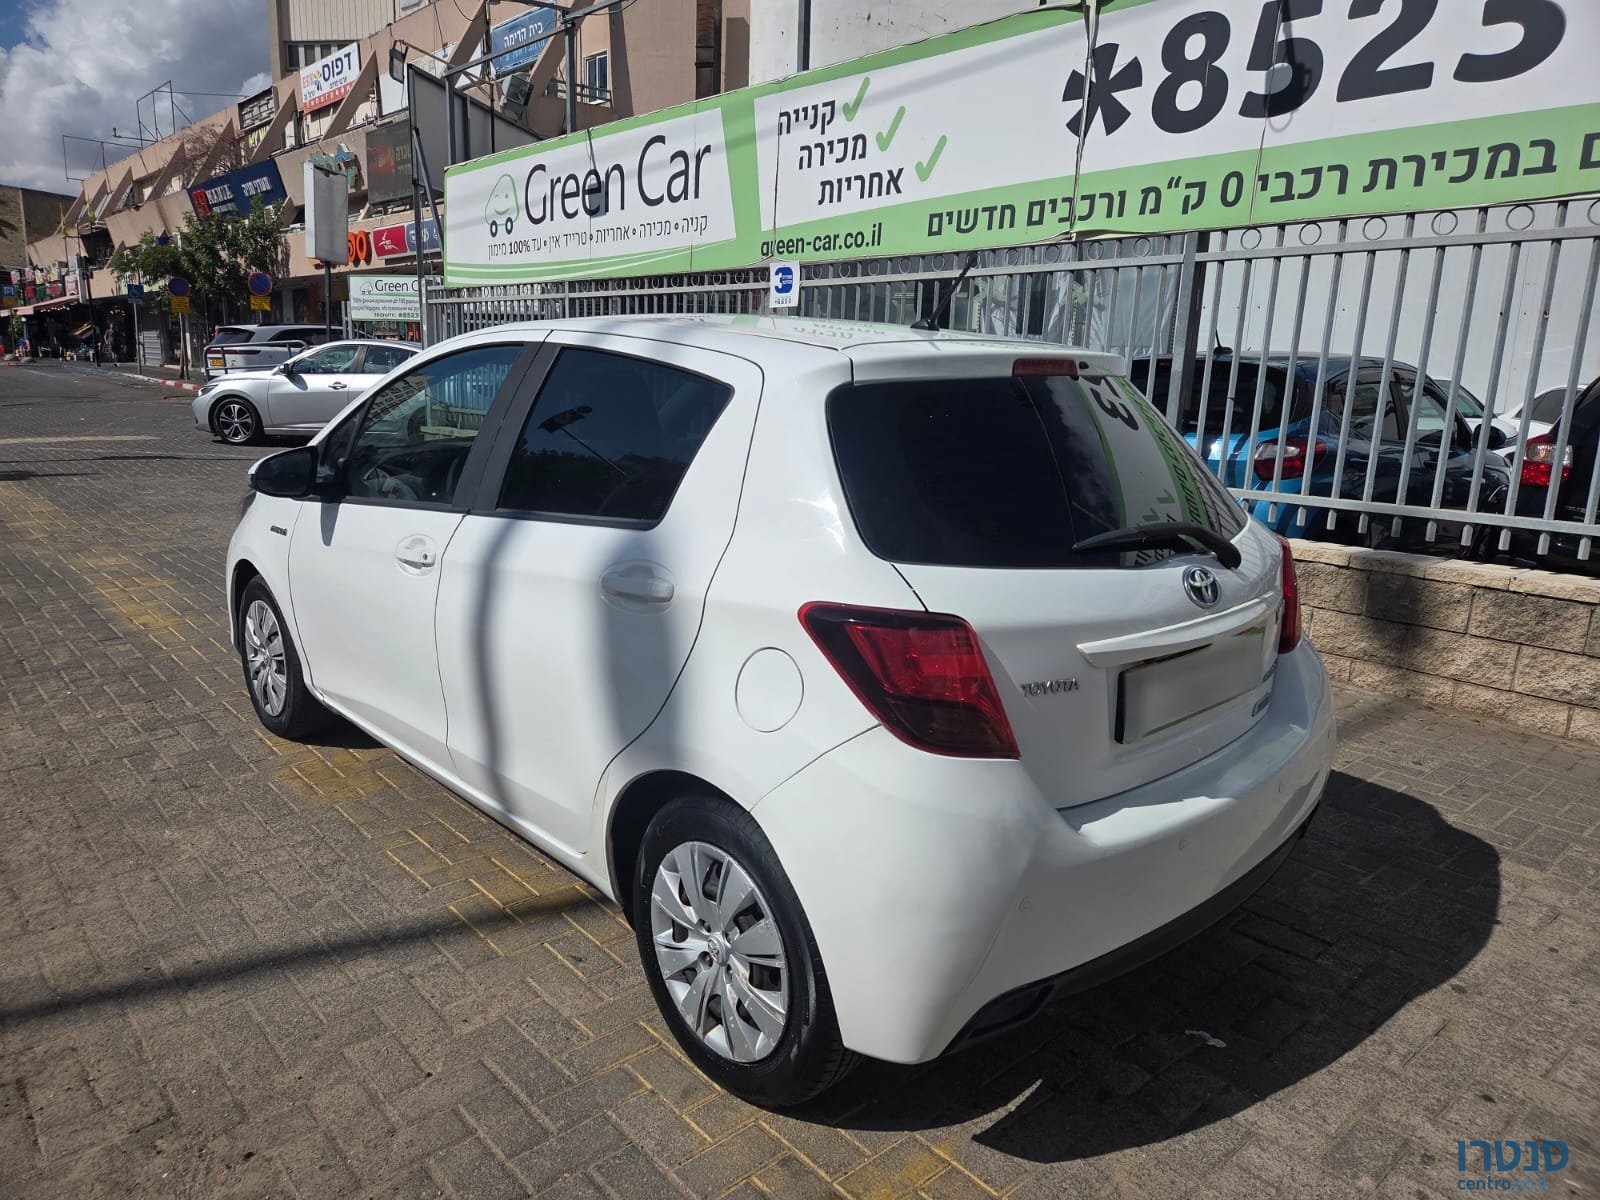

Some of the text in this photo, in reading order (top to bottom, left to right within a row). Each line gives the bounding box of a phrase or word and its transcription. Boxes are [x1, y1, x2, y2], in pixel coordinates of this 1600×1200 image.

[322, 52, 352, 82] דפוס
[779, 100, 836, 136] קנייה
[798, 133, 867, 170] מכירה
[1362, 138, 1557, 193] במכירת
[525, 134, 711, 225] Green Car
[818, 167, 904, 205] אחריות
[1220, 170, 1244, 208] 0
[1257, 162, 1349, 204] רכבי
[927, 203, 1016, 237] חדשים
[1026, 190, 1126, 227] ורכבים
[531, 237, 543, 248] עד
[595, 226, 630, 245] אחריות
[639, 220, 672, 239] מכירה
[681, 215, 708, 237] קניה
[509, 239, 531, 255] 100%
[375, 279, 409, 292] Green
[1021, 678, 1079, 697] TOYOTA
